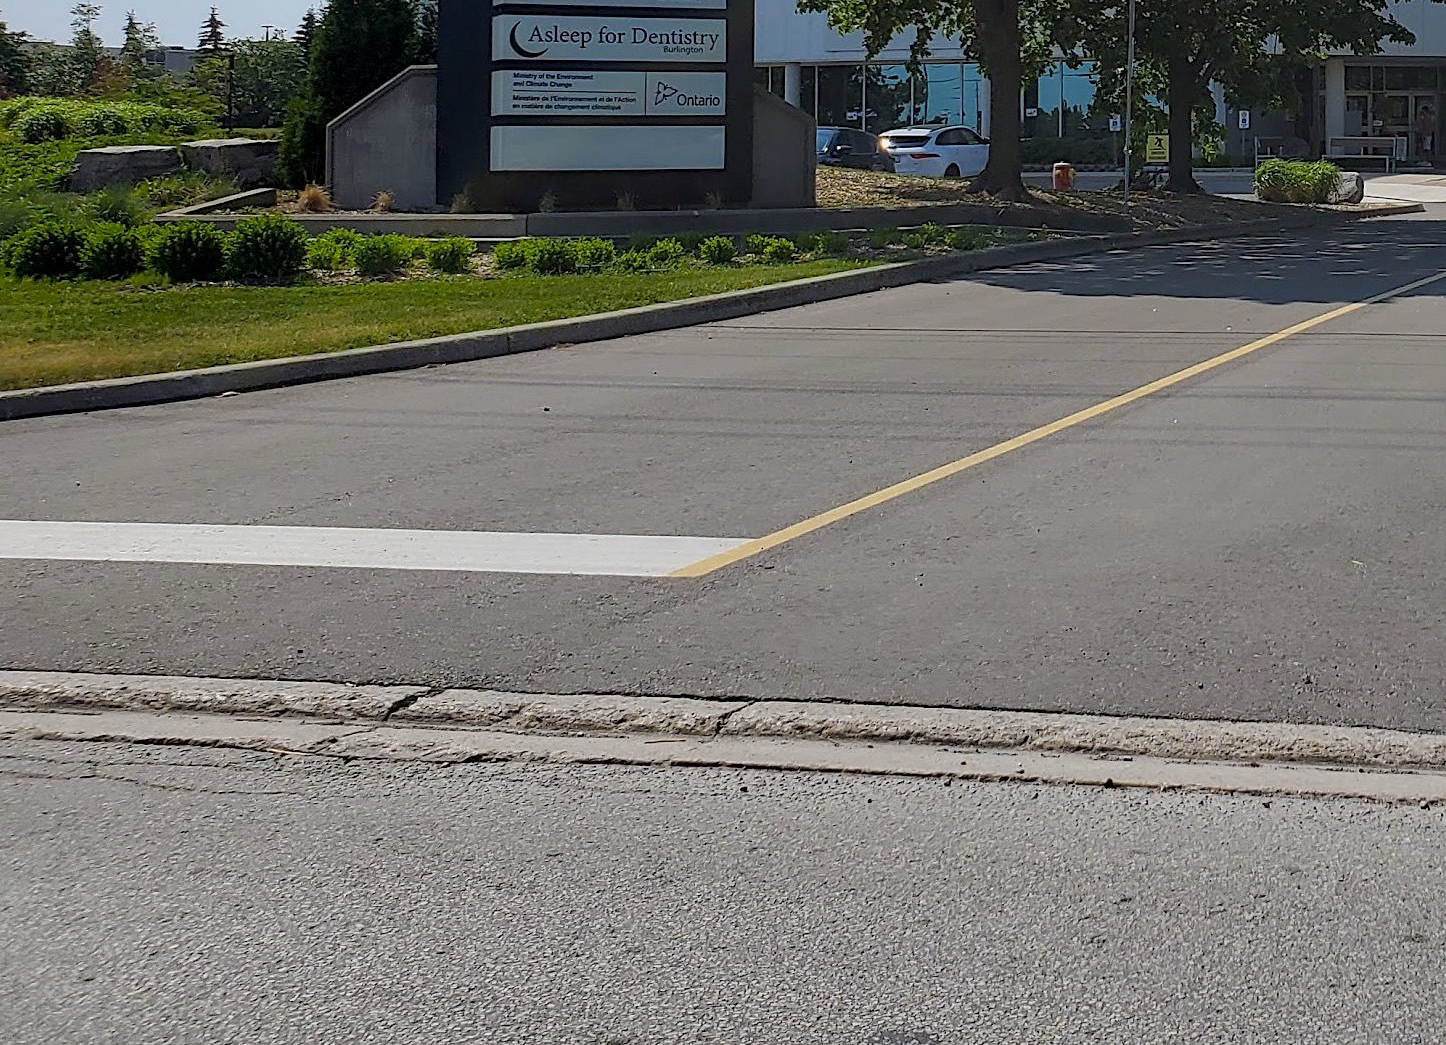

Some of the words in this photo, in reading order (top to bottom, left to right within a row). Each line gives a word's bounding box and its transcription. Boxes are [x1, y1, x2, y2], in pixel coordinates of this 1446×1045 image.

[527, 24, 593, 49] Asleep
[599, 25, 627, 45] for
[630, 26, 720, 51] Dentistry
[663, 45, 704, 55] Burlington
[676, 93, 720, 106] Ontario
